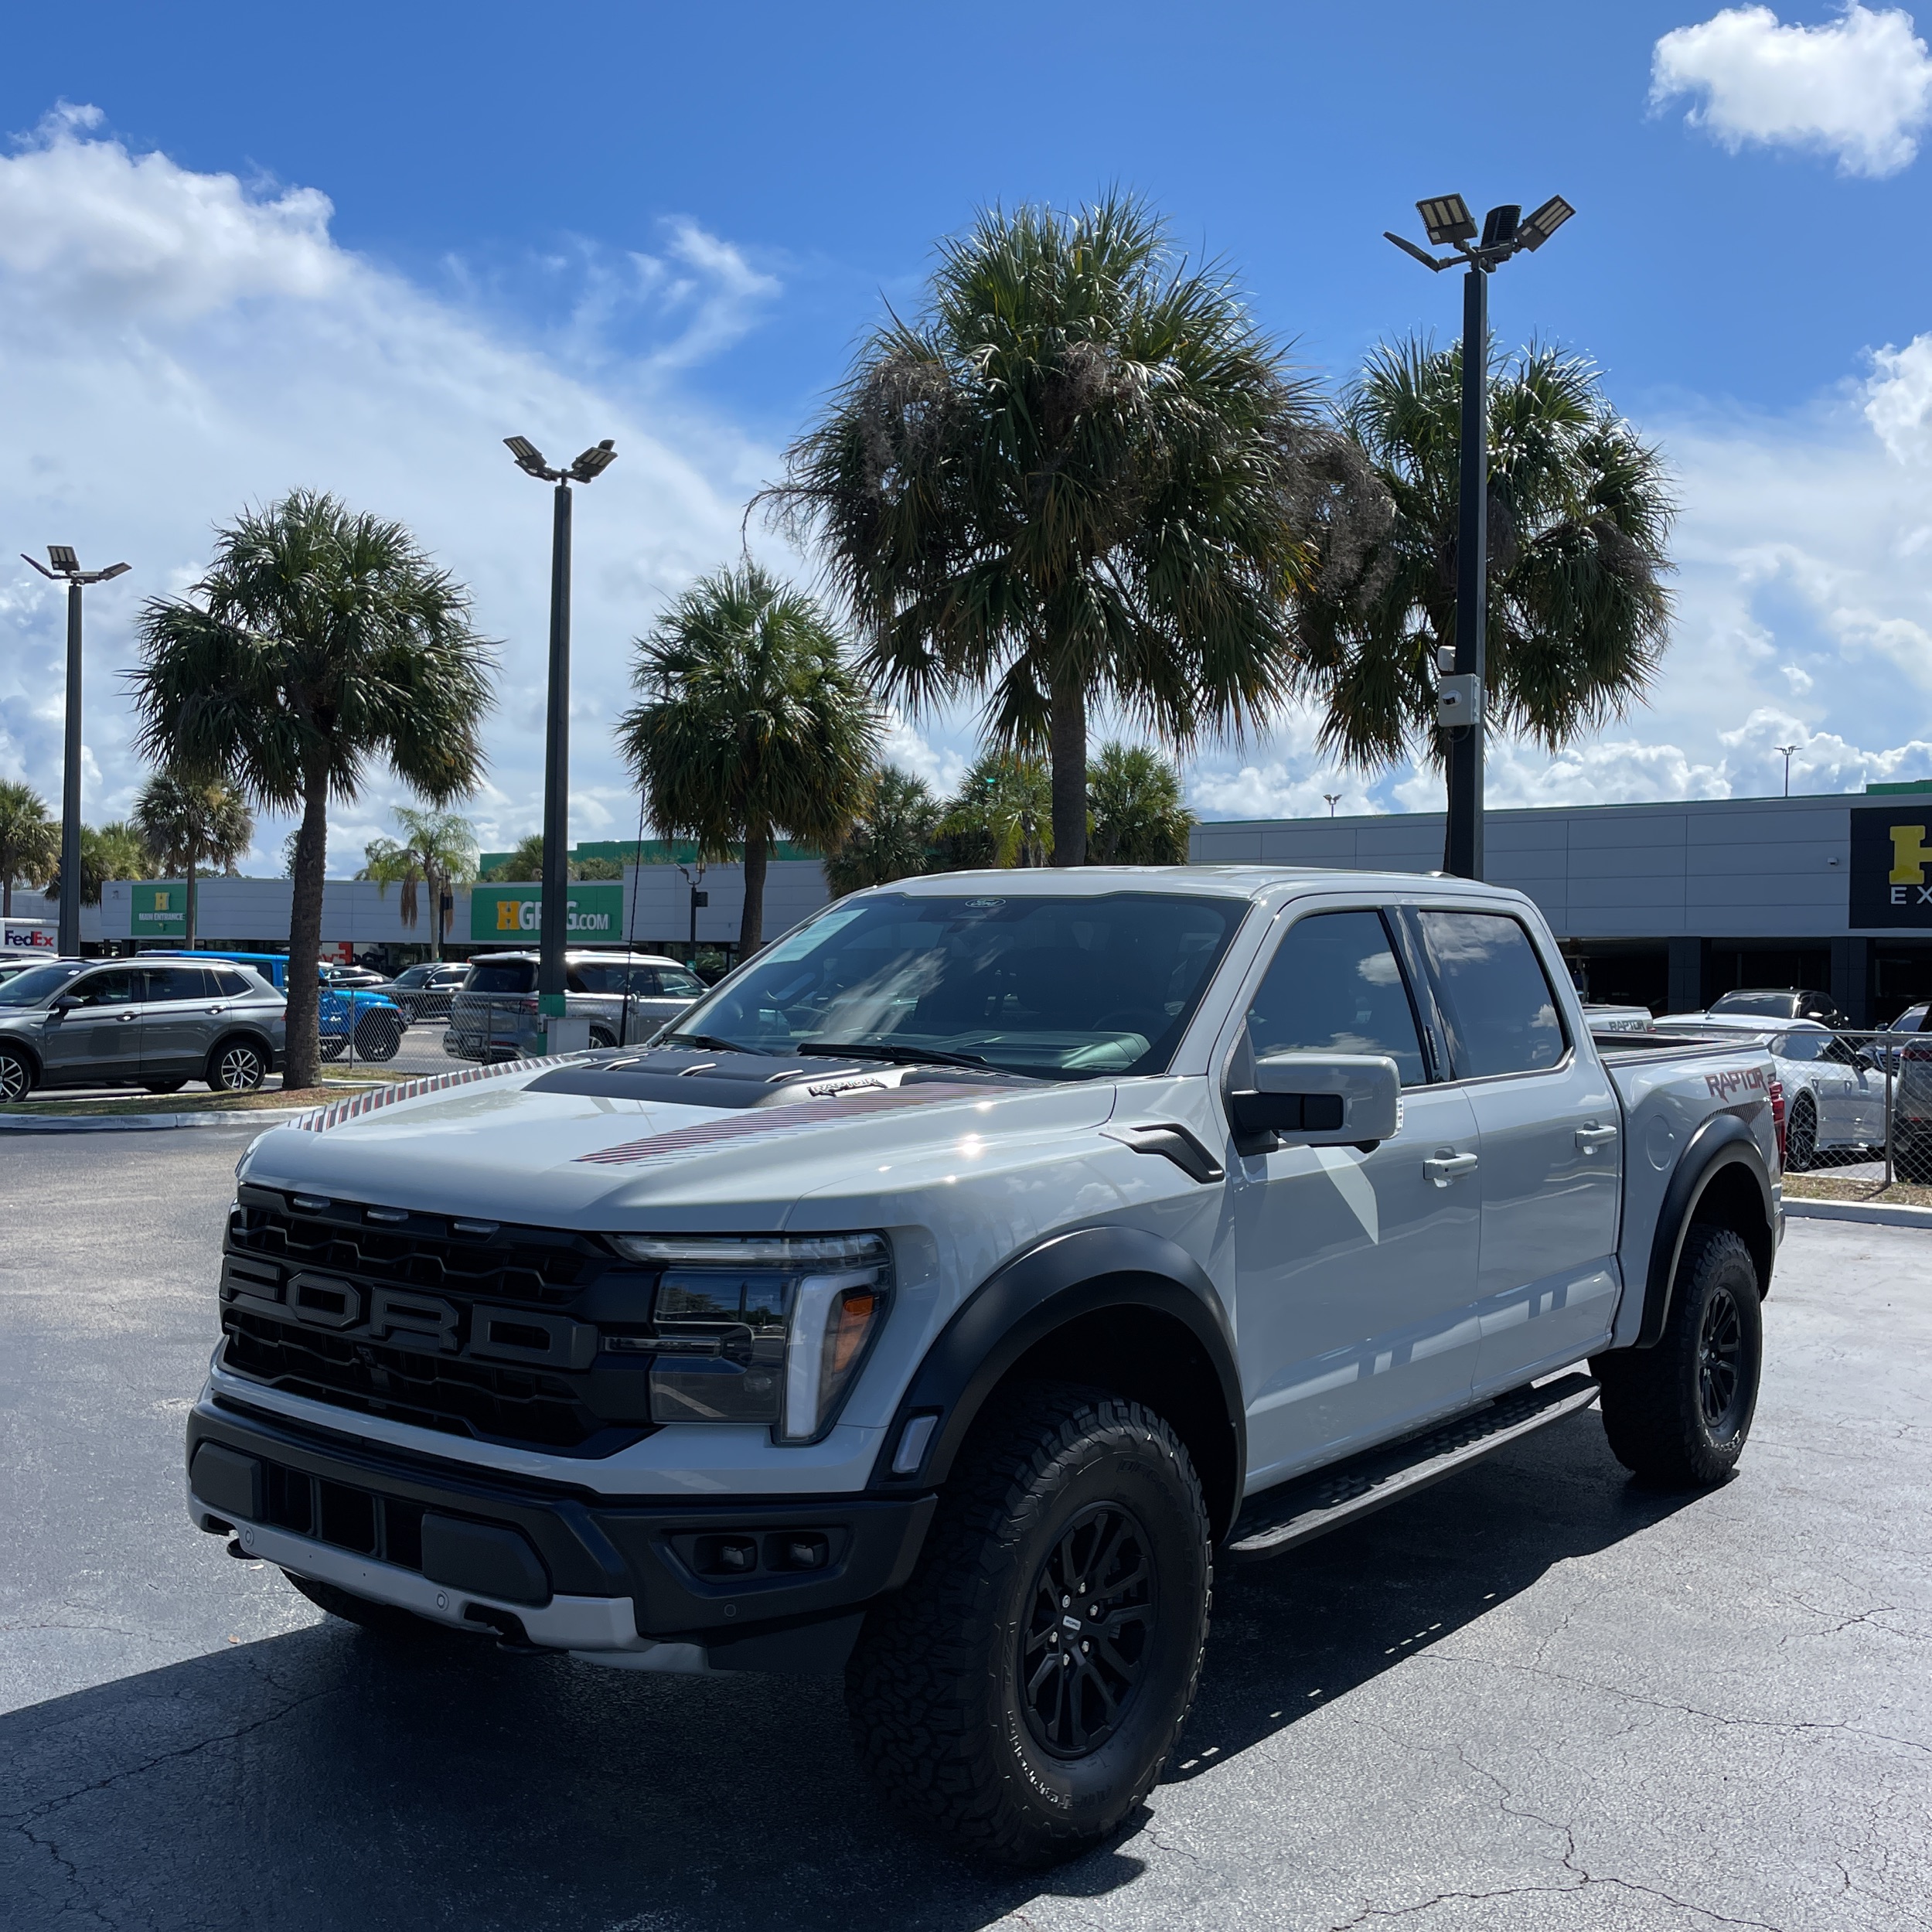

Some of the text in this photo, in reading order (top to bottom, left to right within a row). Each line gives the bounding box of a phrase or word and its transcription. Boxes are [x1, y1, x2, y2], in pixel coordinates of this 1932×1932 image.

[155, 892, 169, 911] H
[497, 901, 608, 930] HGG.COM
[5, 930, 54, 947] FedEx
[1609, 1020, 1646, 1032] RAPTOR
[806, 1078, 888, 1097] RAPTOR
[1705, 1067, 1770, 1103] RAPTOR
[220, 1254, 600, 1369] FORD
